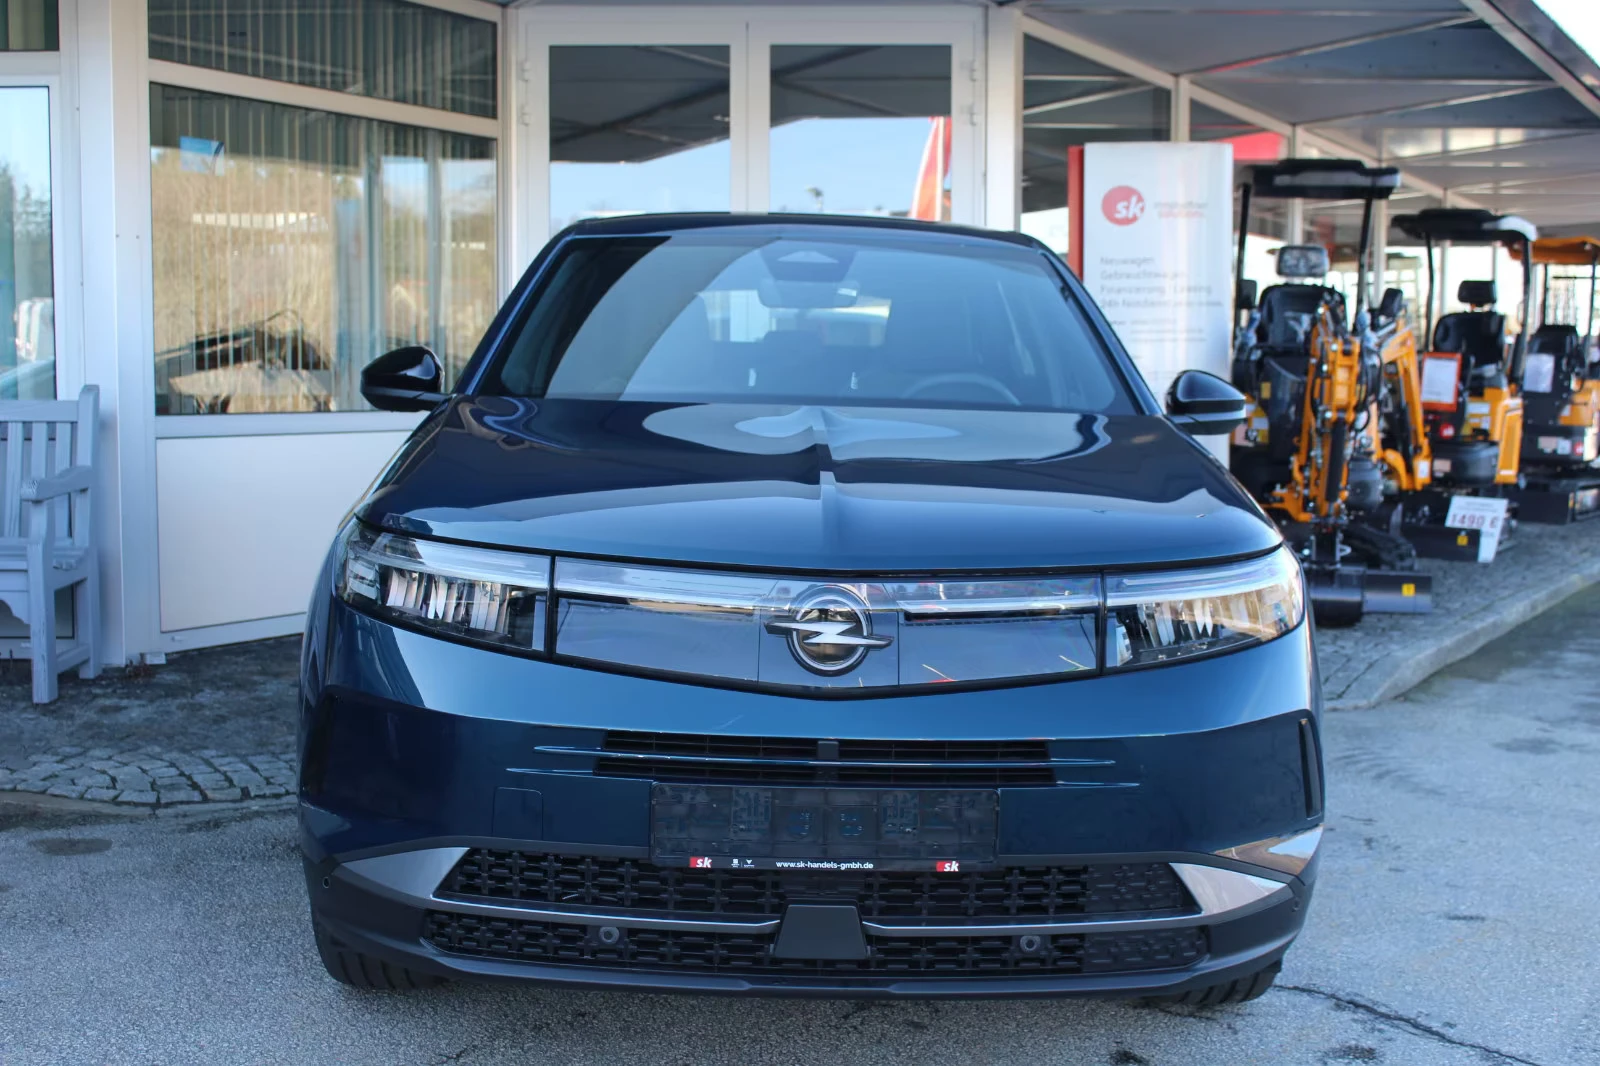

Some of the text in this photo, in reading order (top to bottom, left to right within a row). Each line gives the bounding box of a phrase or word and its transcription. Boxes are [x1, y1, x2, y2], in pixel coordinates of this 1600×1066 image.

[1114, 195, 1145, 219] sk
[696, 857, 960, 872] sk www.sk-handels-gmbh.de sk
